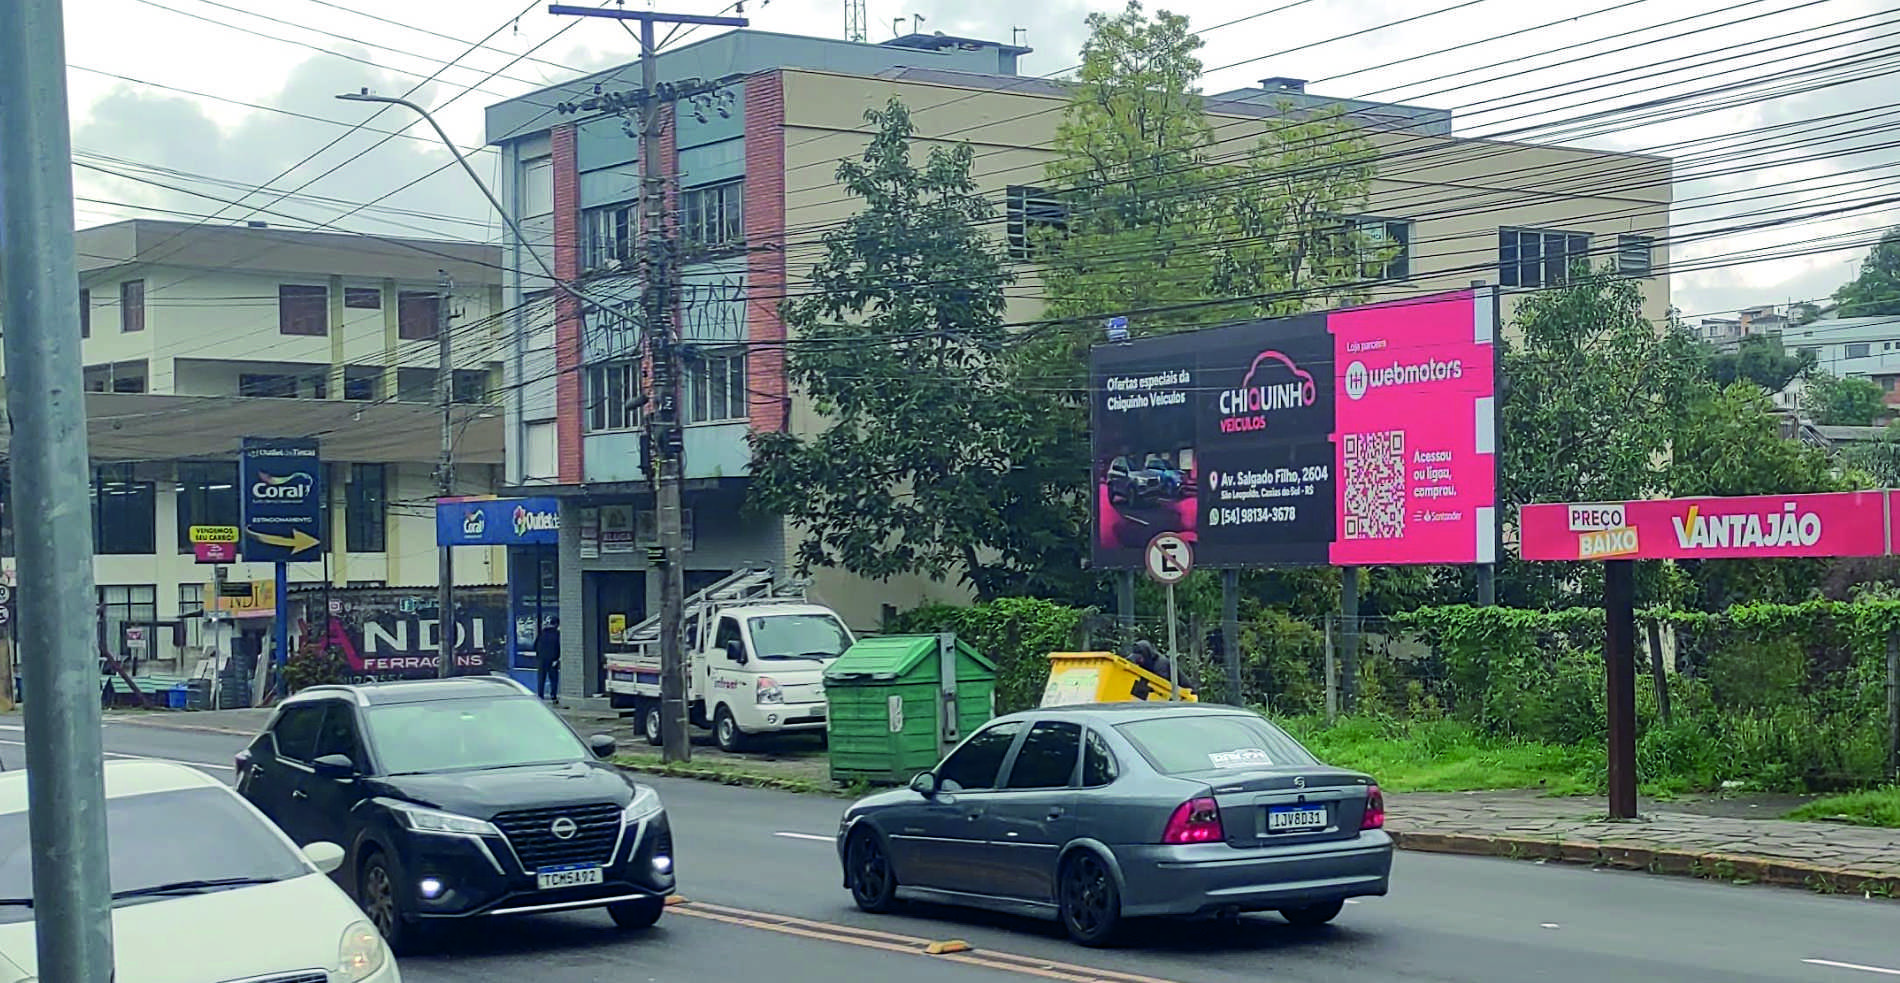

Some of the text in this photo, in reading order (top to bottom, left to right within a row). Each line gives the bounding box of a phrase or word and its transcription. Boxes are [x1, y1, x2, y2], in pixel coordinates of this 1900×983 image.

[1107, 369, 1190, 391] Ofertas especiais da
[1369, 356, 1462, 388] webmotors
[1107, 394, 1149, 412] Chiquinho
[1220, 381, 1316, 414] CHIQUINHO
[1413, 450, 1452, 464] Acessou
[1221, 465, 1328, 488] Av. Salgado Filho, 2604
[1413, 469, 1425, 481] ou
[252, 482, 304, 498] Coral
[1305, 484, 1315, 495] RS
[1413, 485, 1457, 501] comprou.
[1241, 506, 1296, 523] 98134-3678
[1572, 510, 1622, 530] PREÇO
[1671, 502, 1822, 549] VANTAJÃO
[1581, 529, 1637, 555] BAIXO
